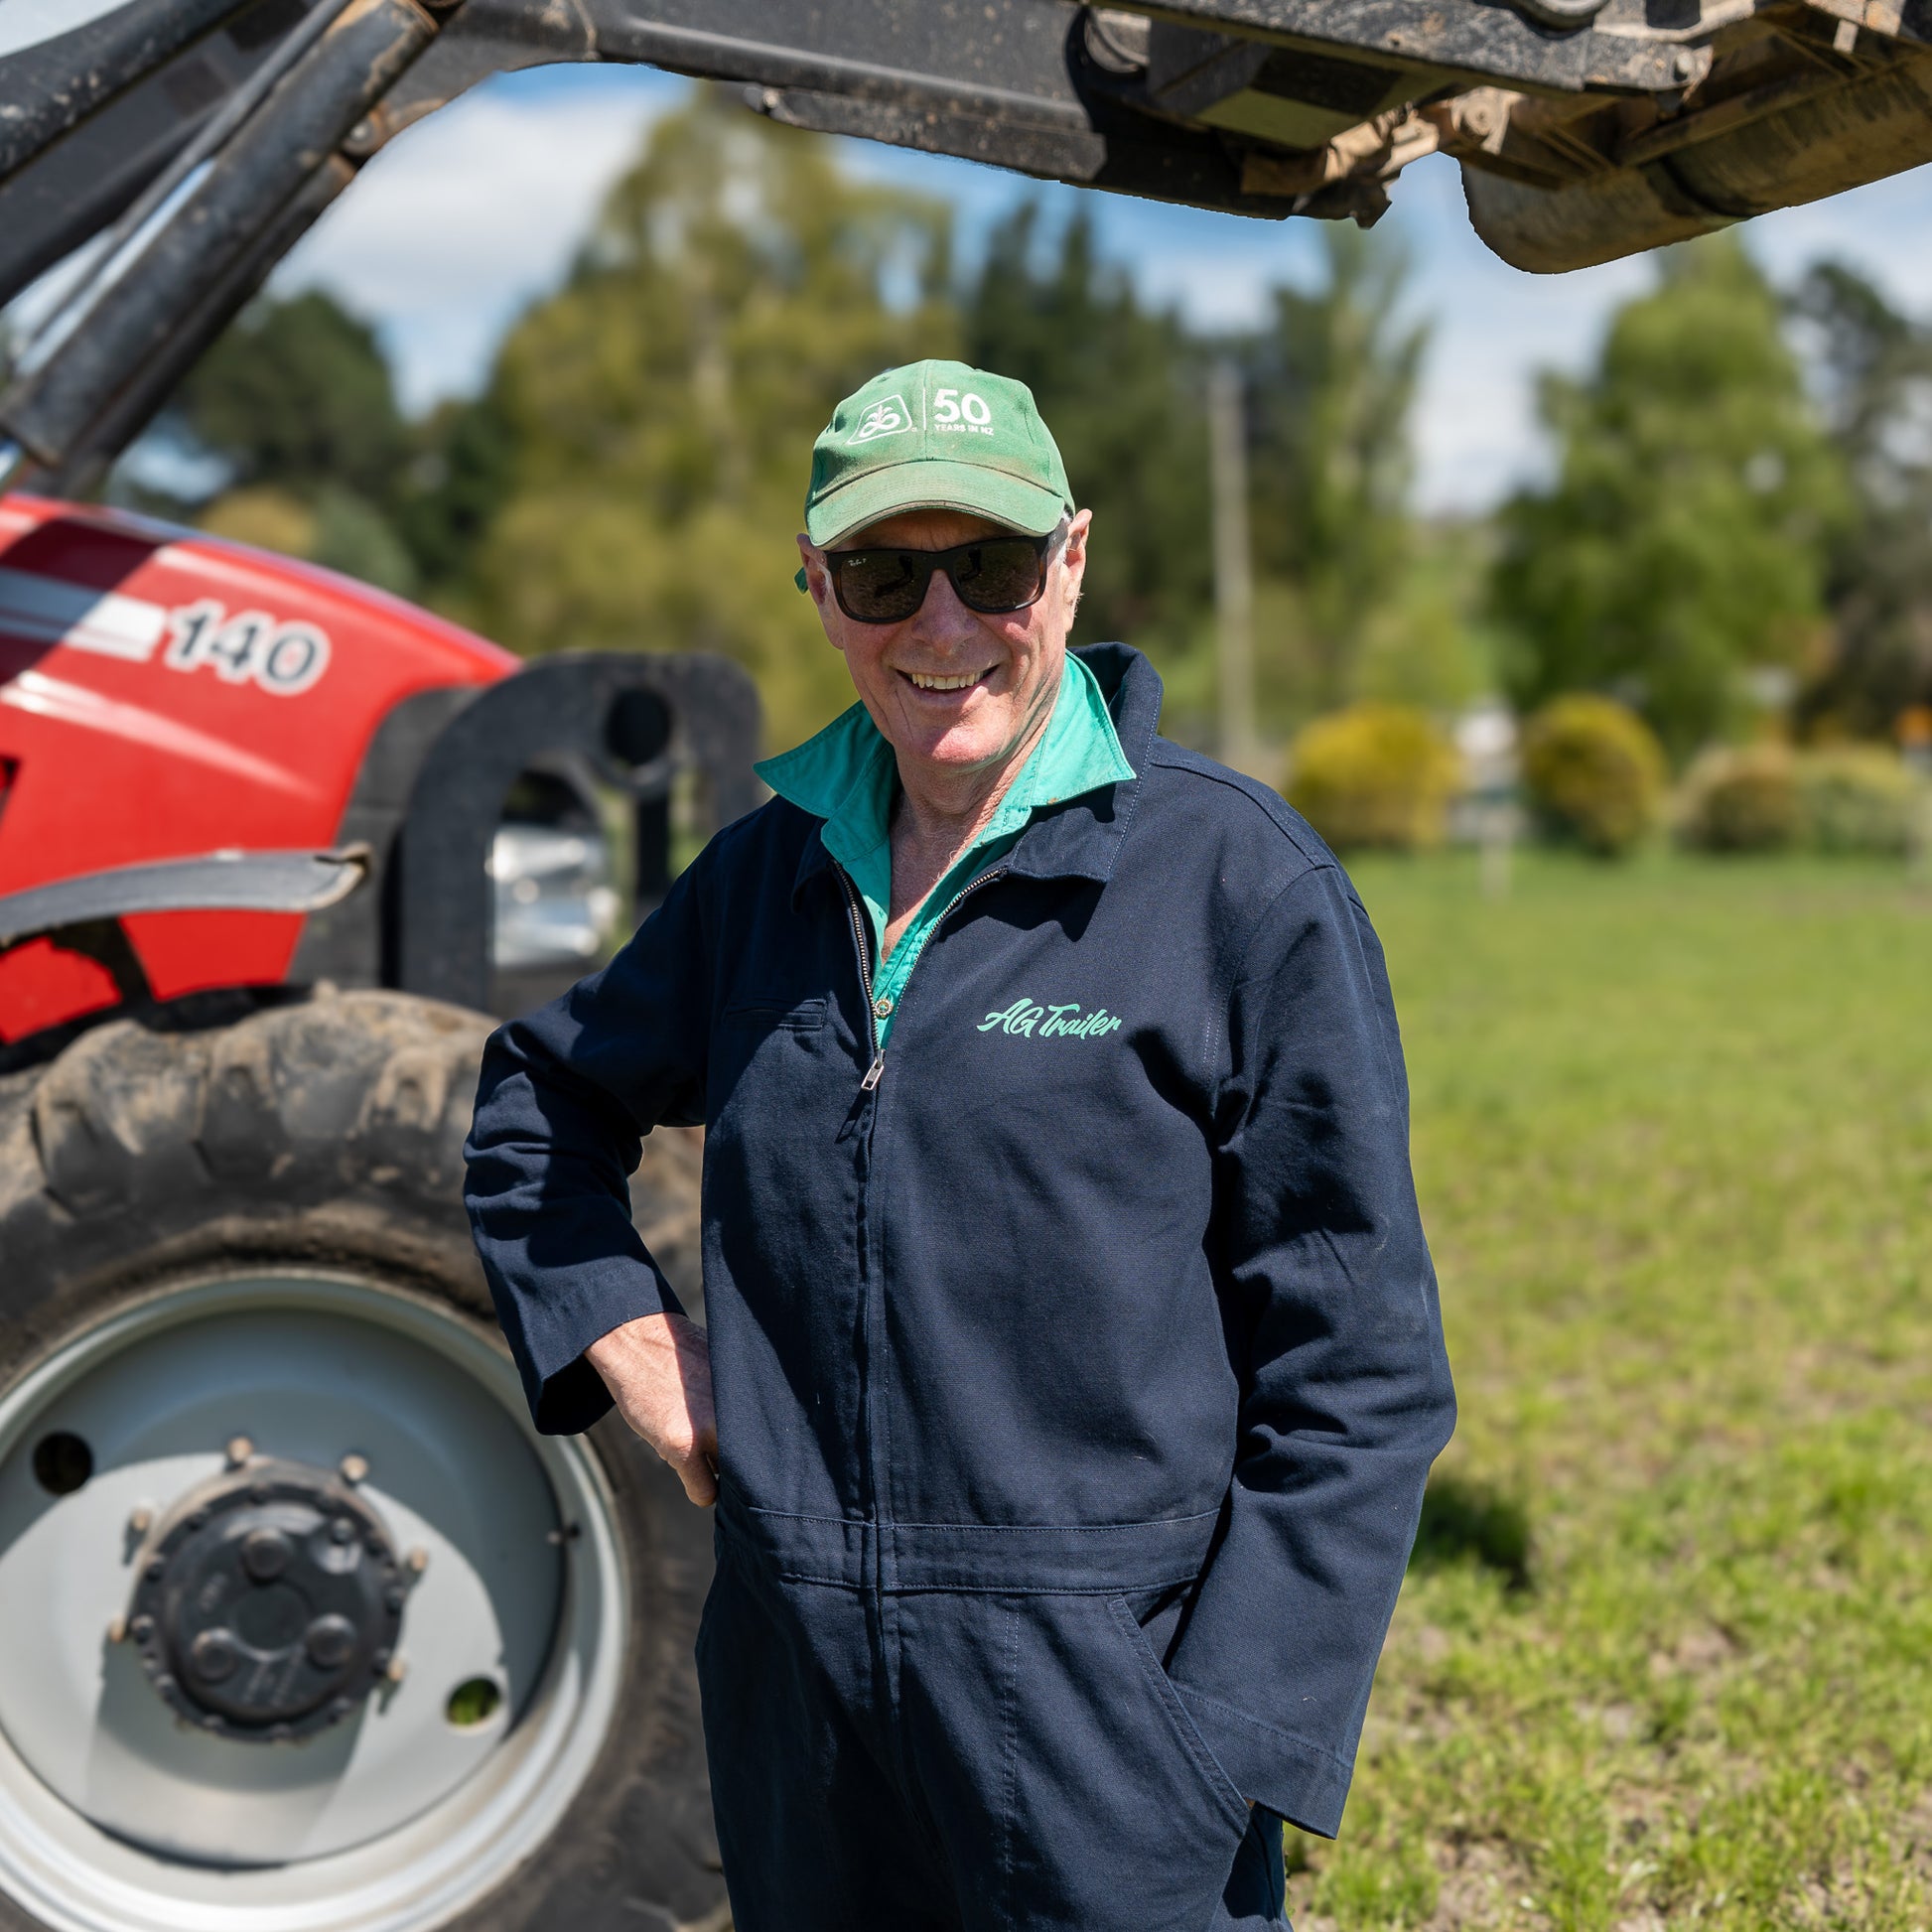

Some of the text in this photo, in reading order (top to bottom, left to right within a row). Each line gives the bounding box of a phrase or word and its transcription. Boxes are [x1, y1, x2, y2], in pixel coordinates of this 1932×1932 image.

[933, 388, 992, 425] 50
[933, 423, 995, 436] YEARS IN NZ
[168, 602, 329, 693] 140
[976, 998, 1122, 1040] AG Trailer
